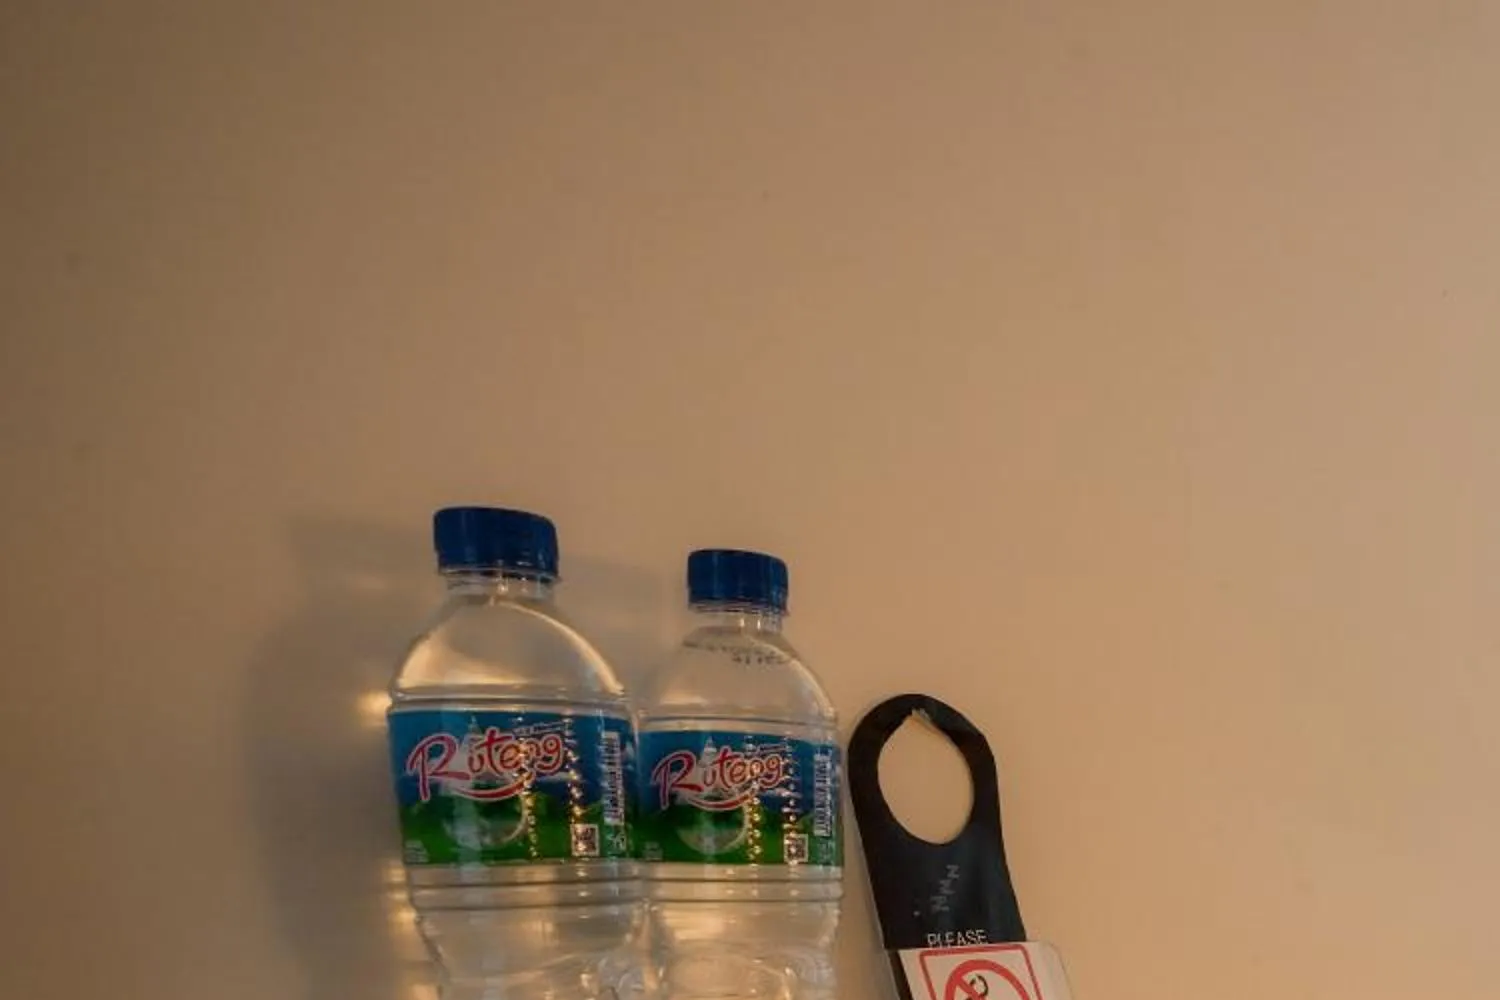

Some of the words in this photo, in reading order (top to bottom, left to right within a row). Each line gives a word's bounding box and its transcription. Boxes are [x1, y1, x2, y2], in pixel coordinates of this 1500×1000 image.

[406, 726, 565, 802] Ruteng
[651, 746, 783, 809] Ruteng
[927, 929, 988, 948] PLEASE
